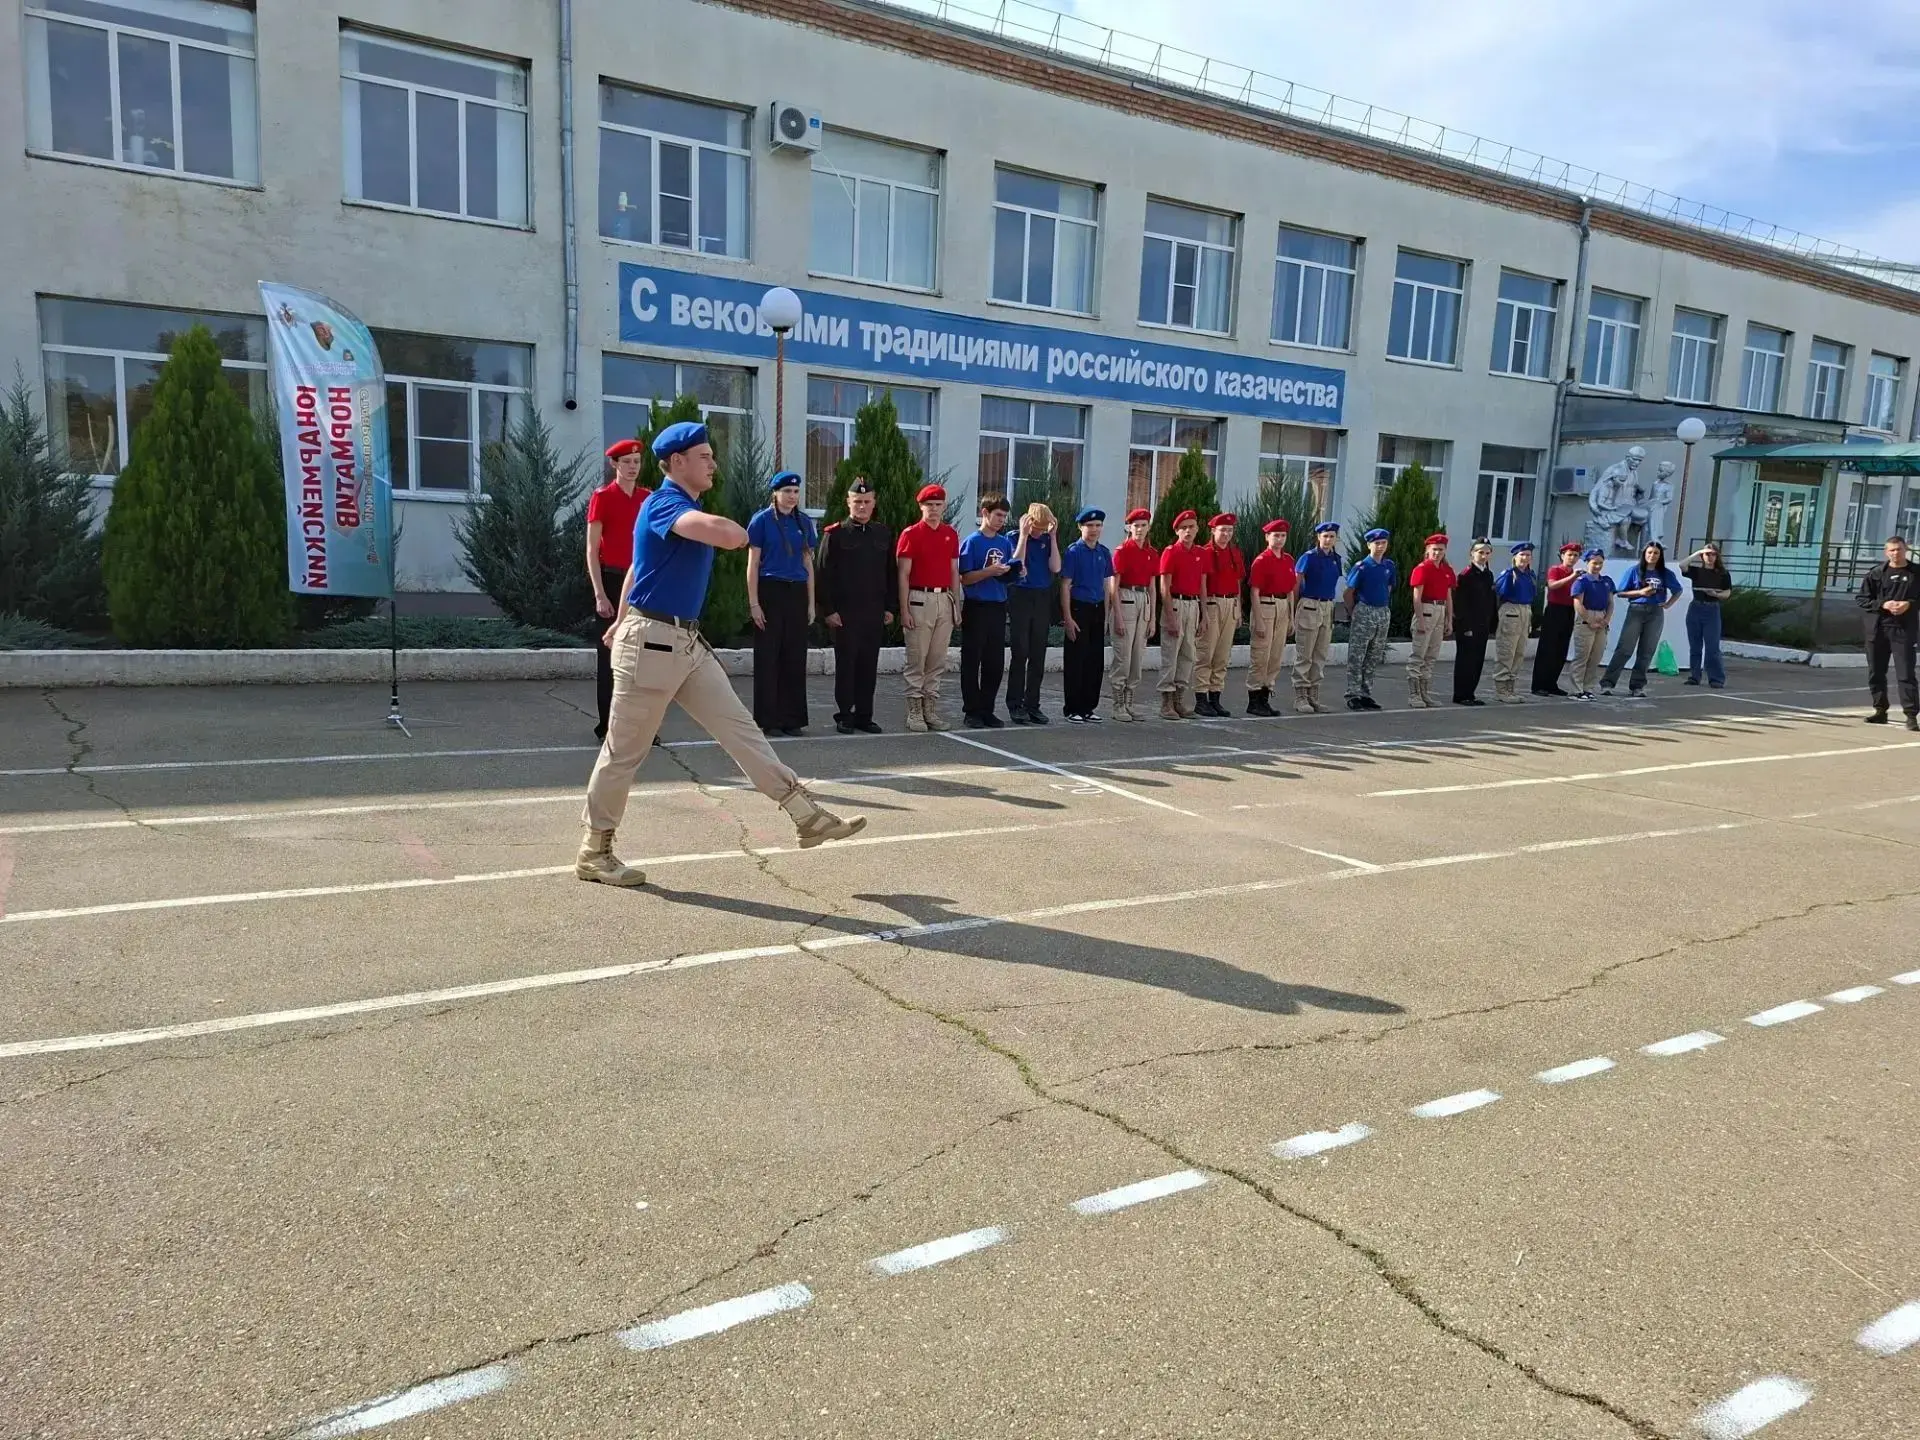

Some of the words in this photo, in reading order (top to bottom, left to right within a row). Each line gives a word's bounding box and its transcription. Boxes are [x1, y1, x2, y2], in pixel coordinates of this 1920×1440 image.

[631, 277, 658, 322] С
[859, 320, 1038, 371] традициями
[1047, 347, 1208, 393] российского
[1214, 370, 1338, 408] казачества
